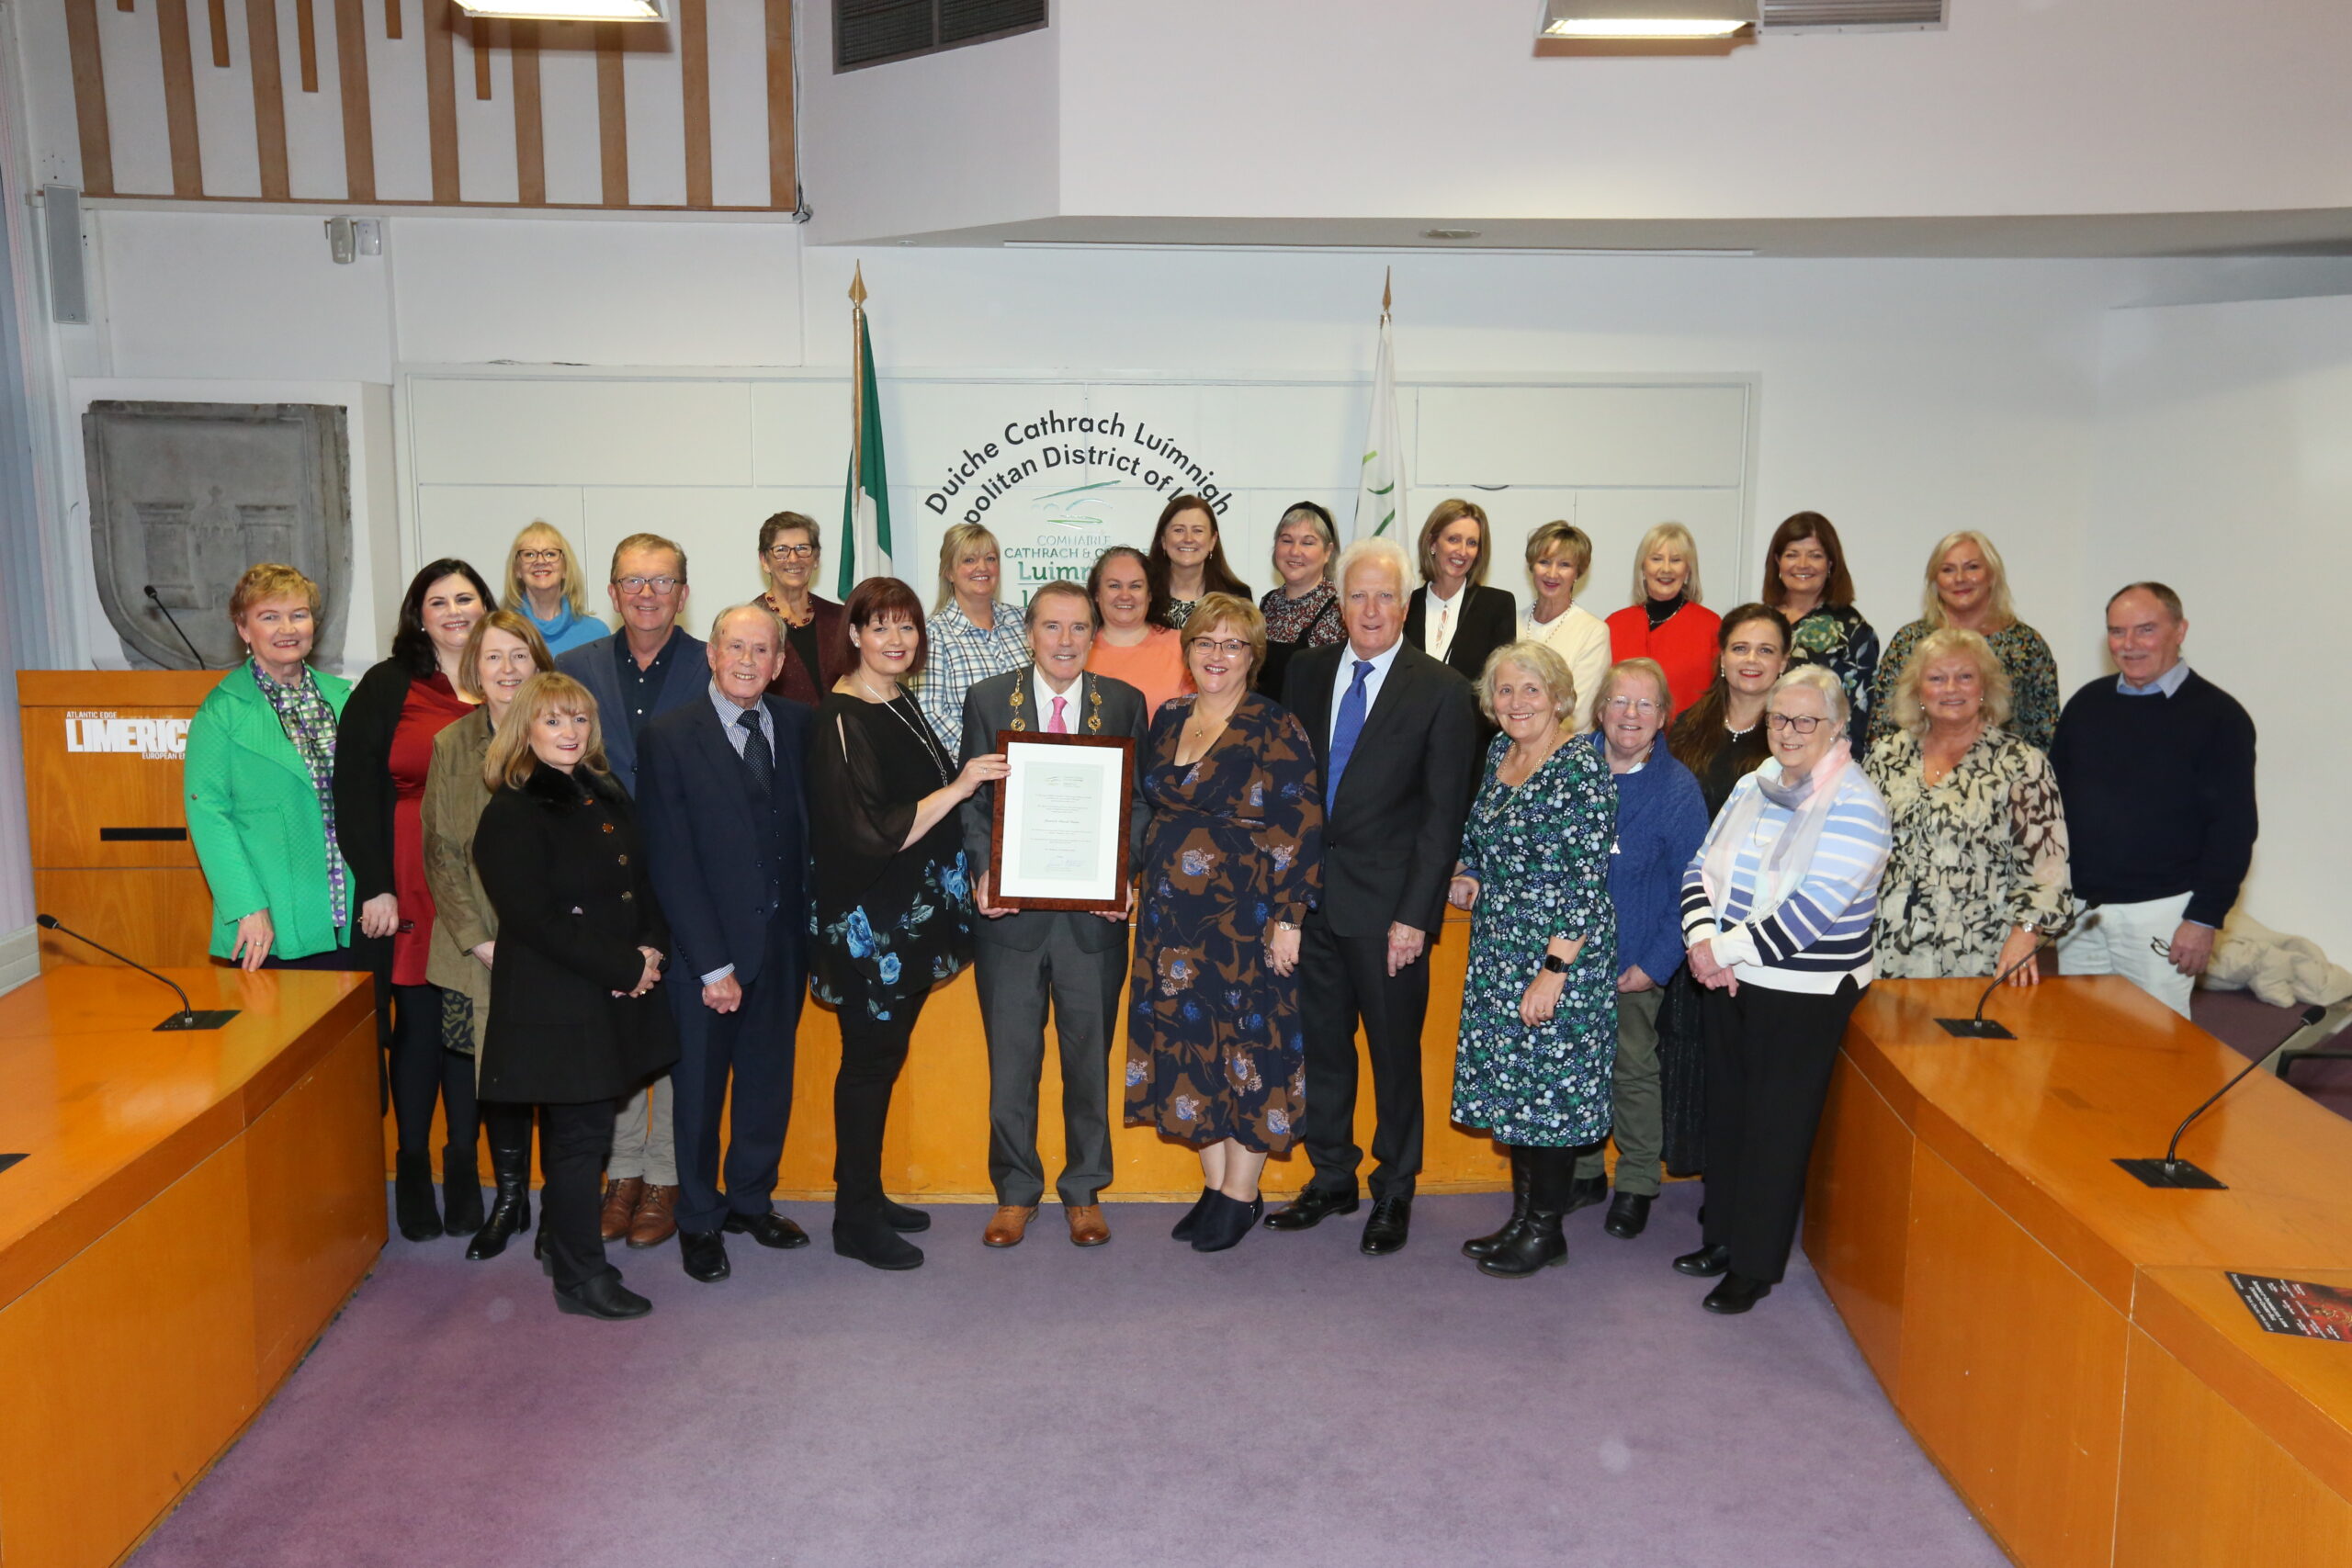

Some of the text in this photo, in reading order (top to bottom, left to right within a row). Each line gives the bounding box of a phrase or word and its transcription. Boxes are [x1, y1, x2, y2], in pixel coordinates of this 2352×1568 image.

[924, 443, 1000, 515] Duiche
[1004, 410, 1125, 446] Cathrach
[964, 444, 1174, 525] politan District of
[1004, 547, 1079, 558] CATHRACH
[1082, 548, 1091, 558] &
[1018, 561, 1093, 581] Luimn
[66, 711, 98, 719] ATLANTIC
[99, 711, 118, 719] EDGE
[65, 718, 193, 752] LIMERIC
[141, 752, 176, 761] EUROPEAN
